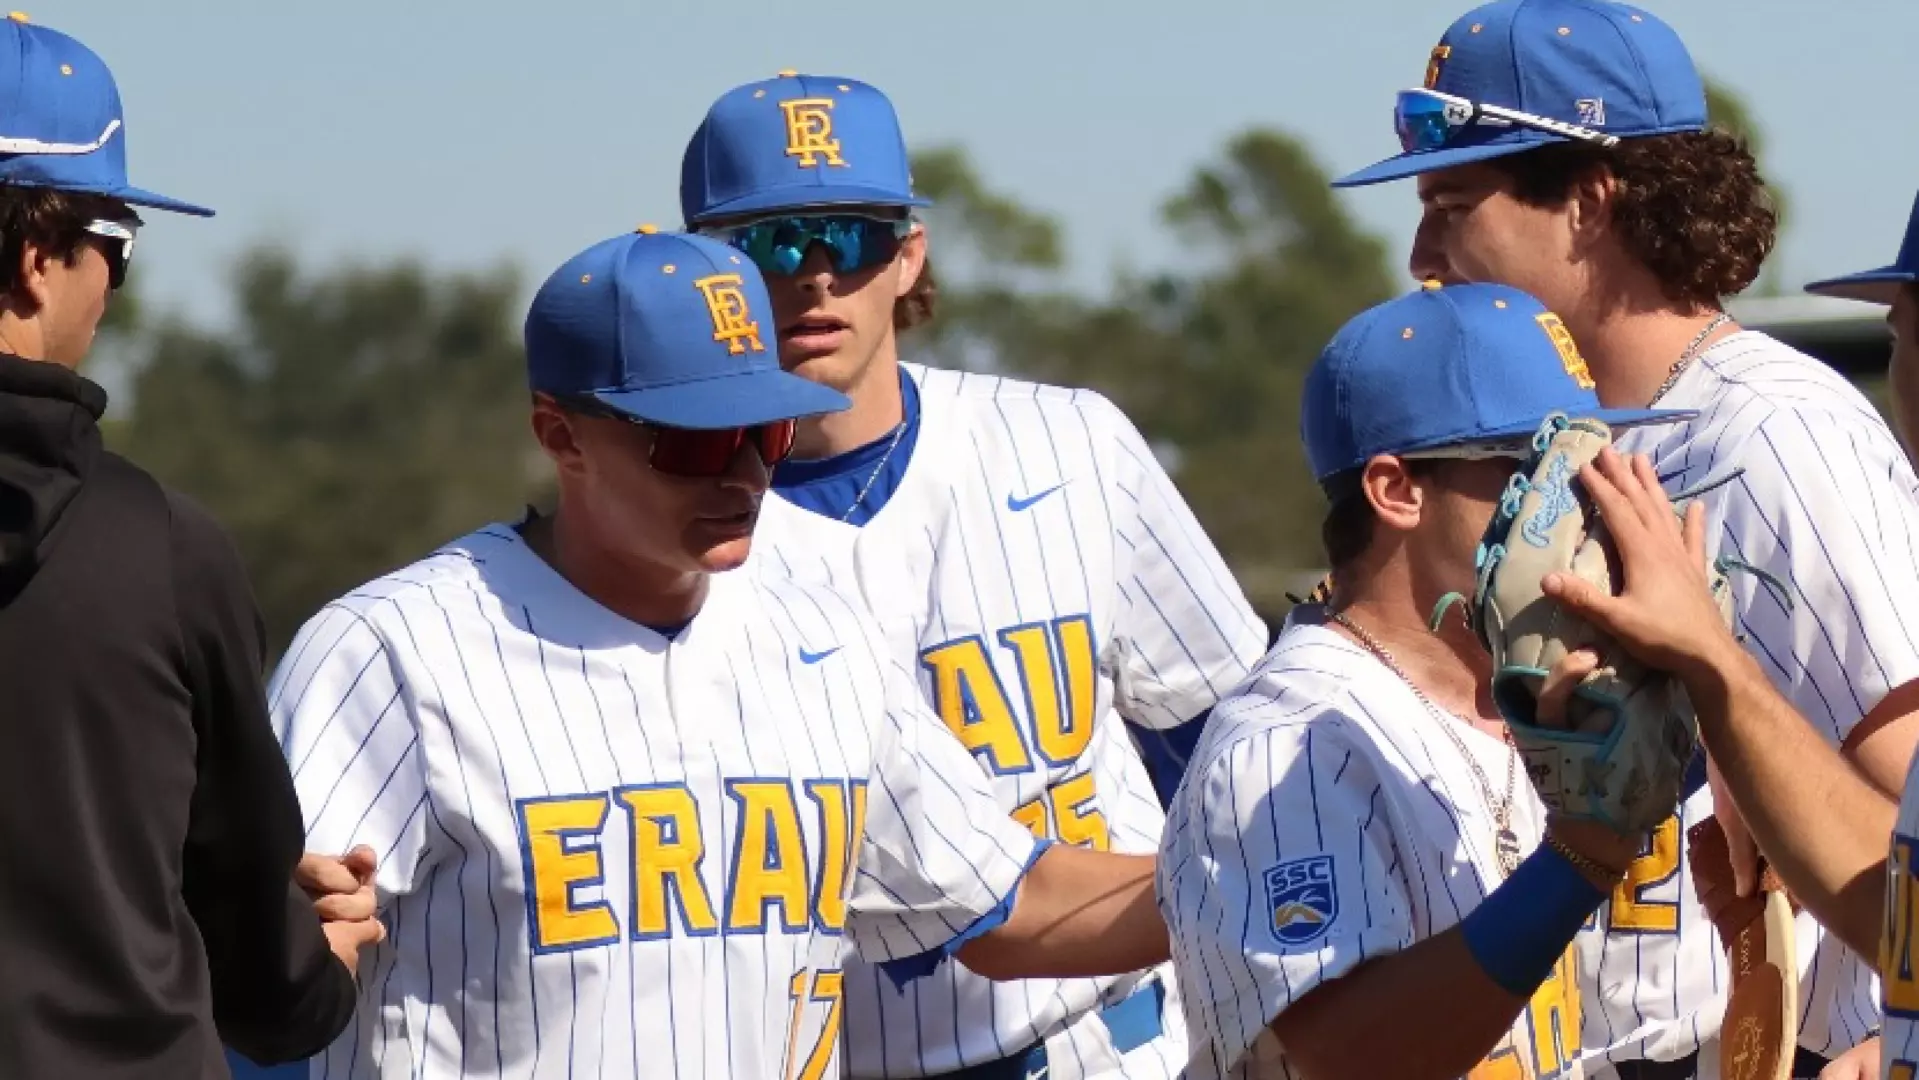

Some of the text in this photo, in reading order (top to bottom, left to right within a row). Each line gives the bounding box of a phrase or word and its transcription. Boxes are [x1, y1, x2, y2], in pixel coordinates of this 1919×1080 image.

[778, 98, 850, 168] ER
[694, 273, 765, 354] ER
[515, 777, 868, 956] ERAU
[1270, 862, 1328, 894] SSC
